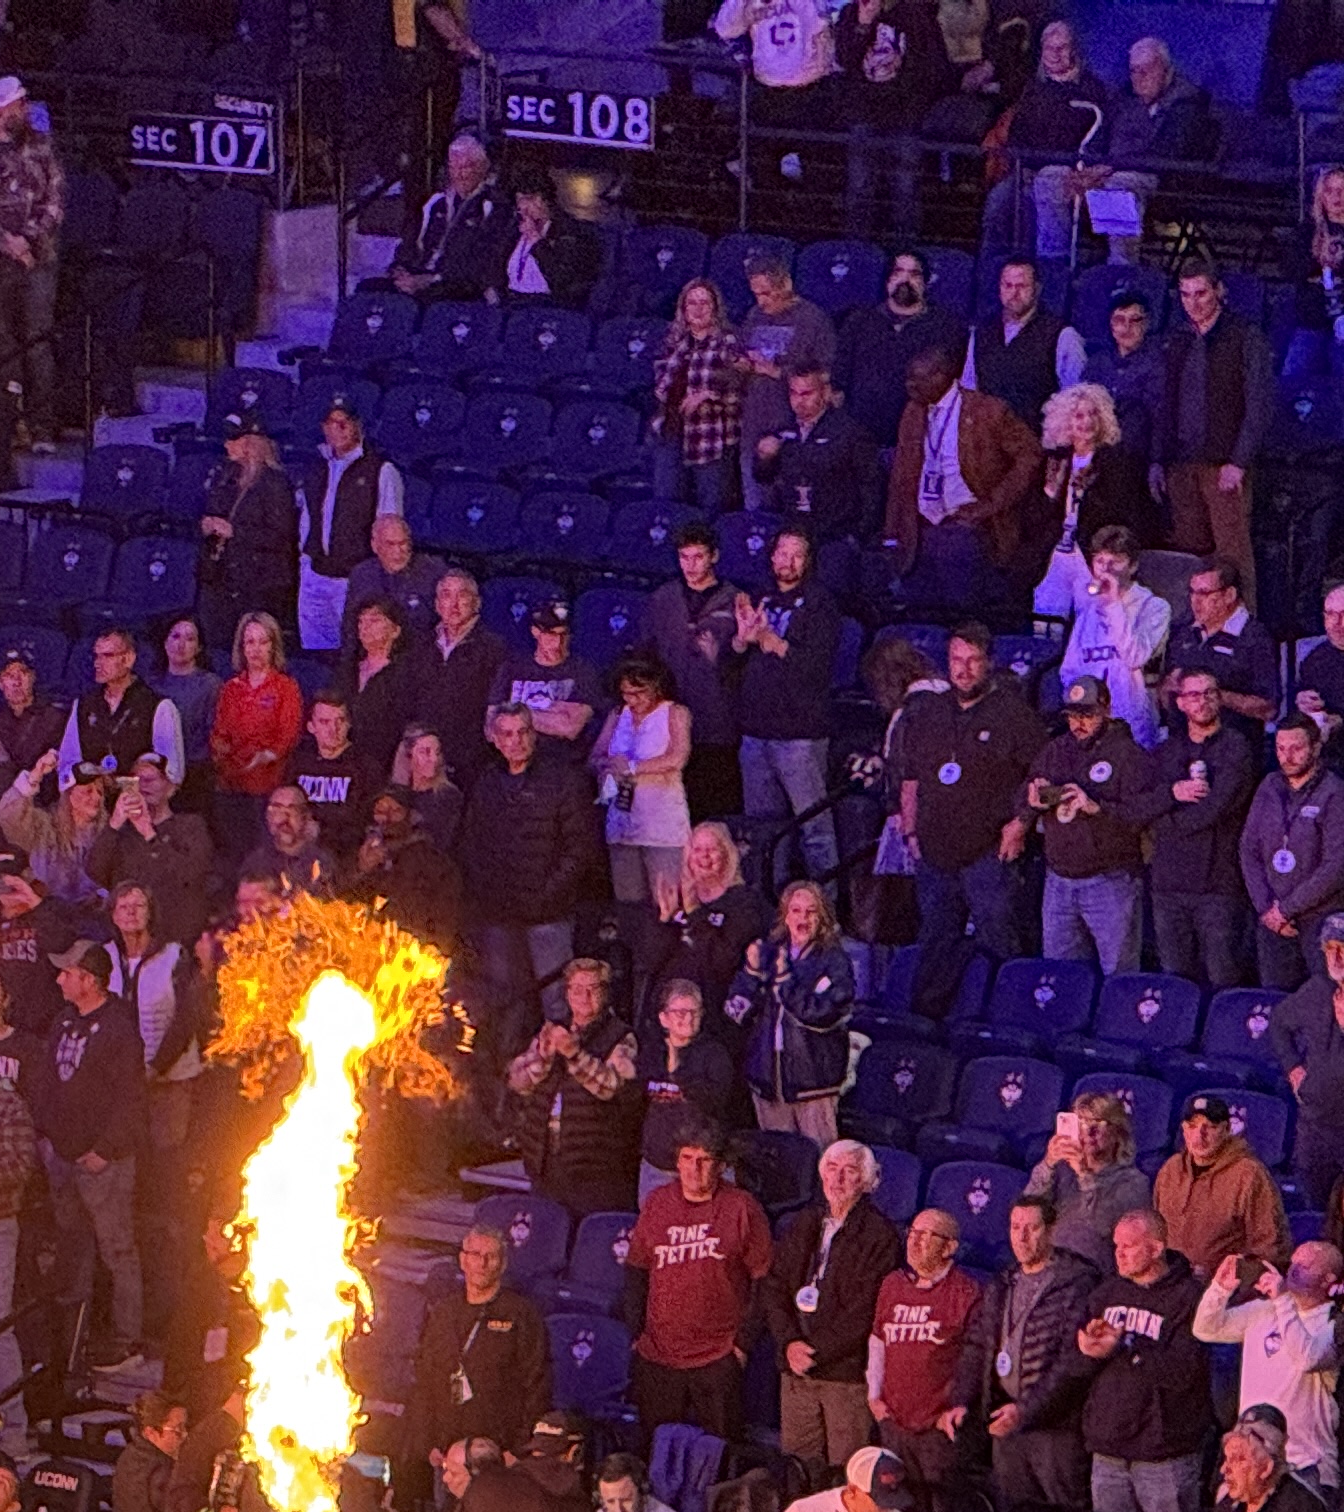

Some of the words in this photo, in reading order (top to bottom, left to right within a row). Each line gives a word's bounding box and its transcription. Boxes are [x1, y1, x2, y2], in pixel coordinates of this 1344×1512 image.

[505, 94, 556, 125] SEC
[566, 91, 651, 142] 108
[130, 125, 177, 154] SEC
[187, 119, 269, 167] 107
[666, 1223, 713, 1247] FINE
[653, 1236, 726, 1270] TETTLE
[893, 1303, 933, 1324] FINE
[1103, 1305, 1165, 1342] UCONN
[882, 1320, 946, 1346] TETTLE
[33, 1469, 80, 1492] UCONN
